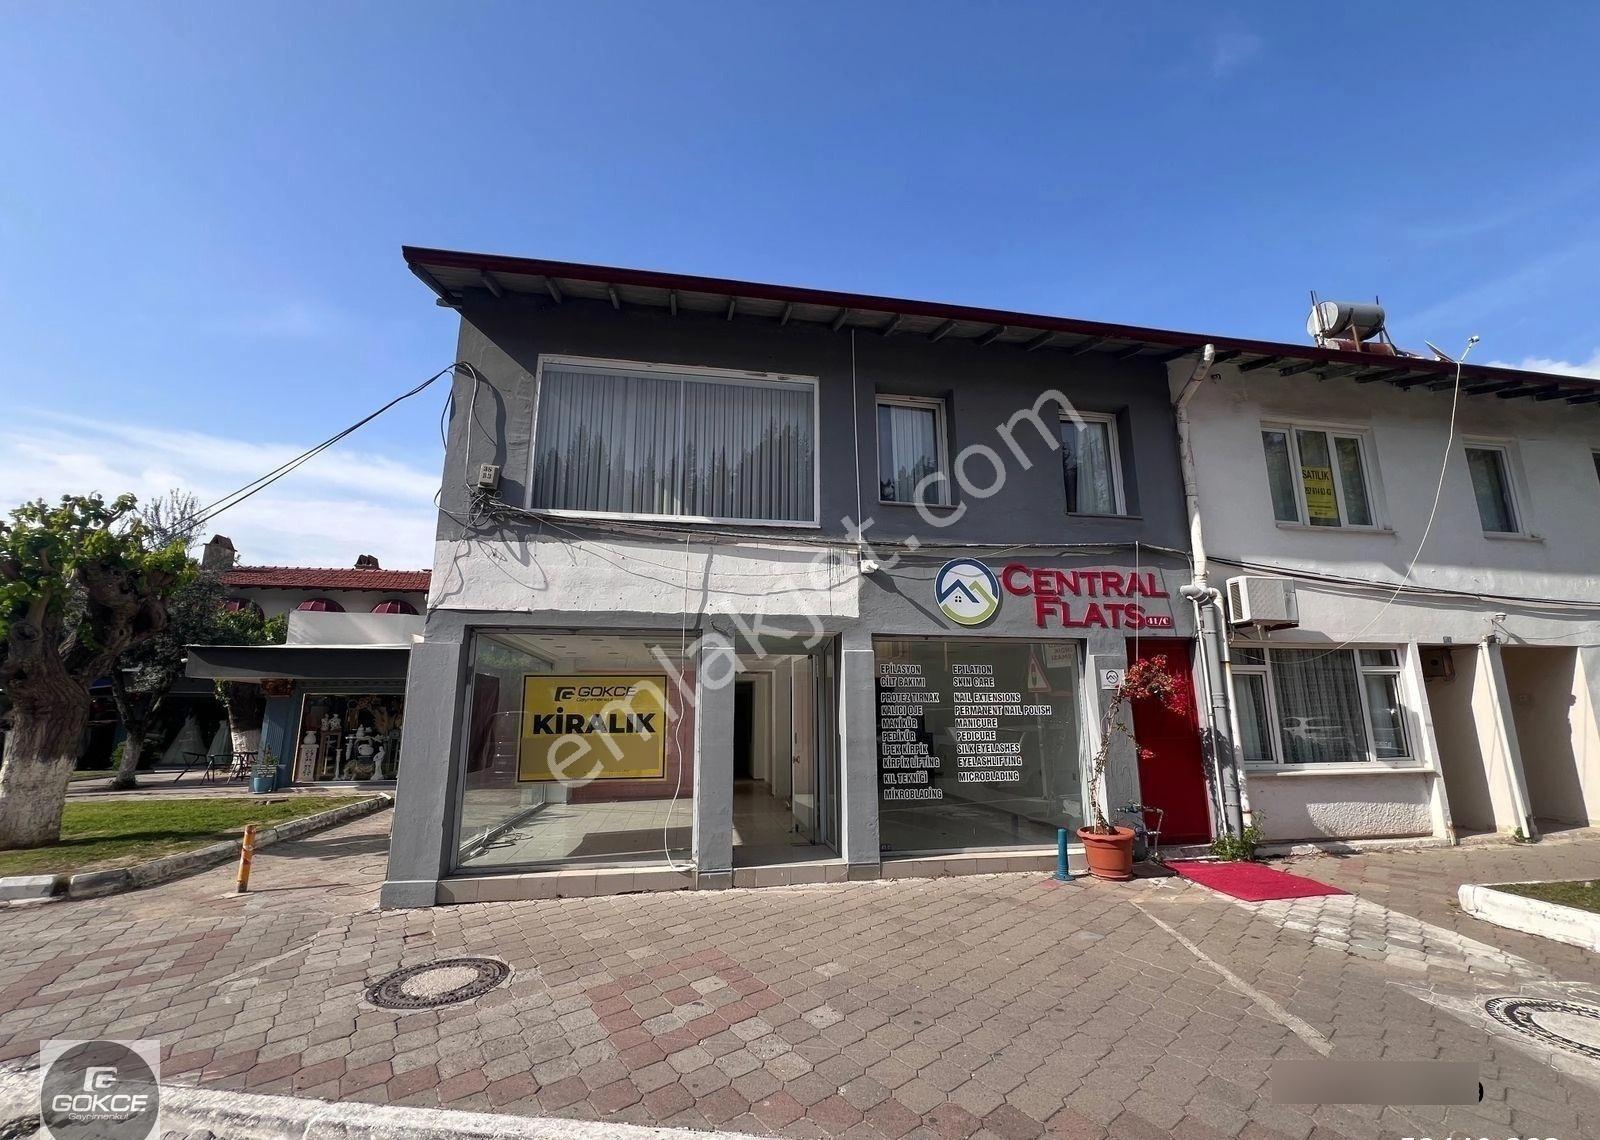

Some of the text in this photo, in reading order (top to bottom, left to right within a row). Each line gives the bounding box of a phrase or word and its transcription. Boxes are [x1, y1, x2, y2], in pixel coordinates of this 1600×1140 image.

[1302, 469, 1330, 480] SATILIK
[1001, 562, 1170, 599] CENTRAL
[1034, 596, 1147, 630] FLATS
[880, 662, 921, 674] EPİLASYON
[952, 664, 992, 674] EPILATION
[880, 675, 926, 687] CİLT BAKIMI
[953, 677, 995, 687] SKIN CARE
[880, 692, 940, 702] PROTEZ TIRNAK
[953, 692, 1021, 702] NAIL EXTENSIONS
[881, 705, 923, 716] KALICI OJE
[954, 705, 1052, 715] PERMANENT NAIL POLISH
[532, 707, 656, 735] KİRALIK
[881, 716, 918, 728] MANİKÜR
[955, 718, 998, 728] MANICURE
[882, 729, 917, 741] PEDİKÜR
[956, 730, 997, 741] PEDICURE
[882, 742, 928, 755] İPEK KİRPİK
[957, 743, 1020, 754] SILK EYELASHES
[883, 755, 910, 768] KİRPİK
[883, 773, 897, 784] KIL
[958, 771, 1020, 782] MICROBLADING
[883, 786, 943, 799] MİKROBLADİNG
